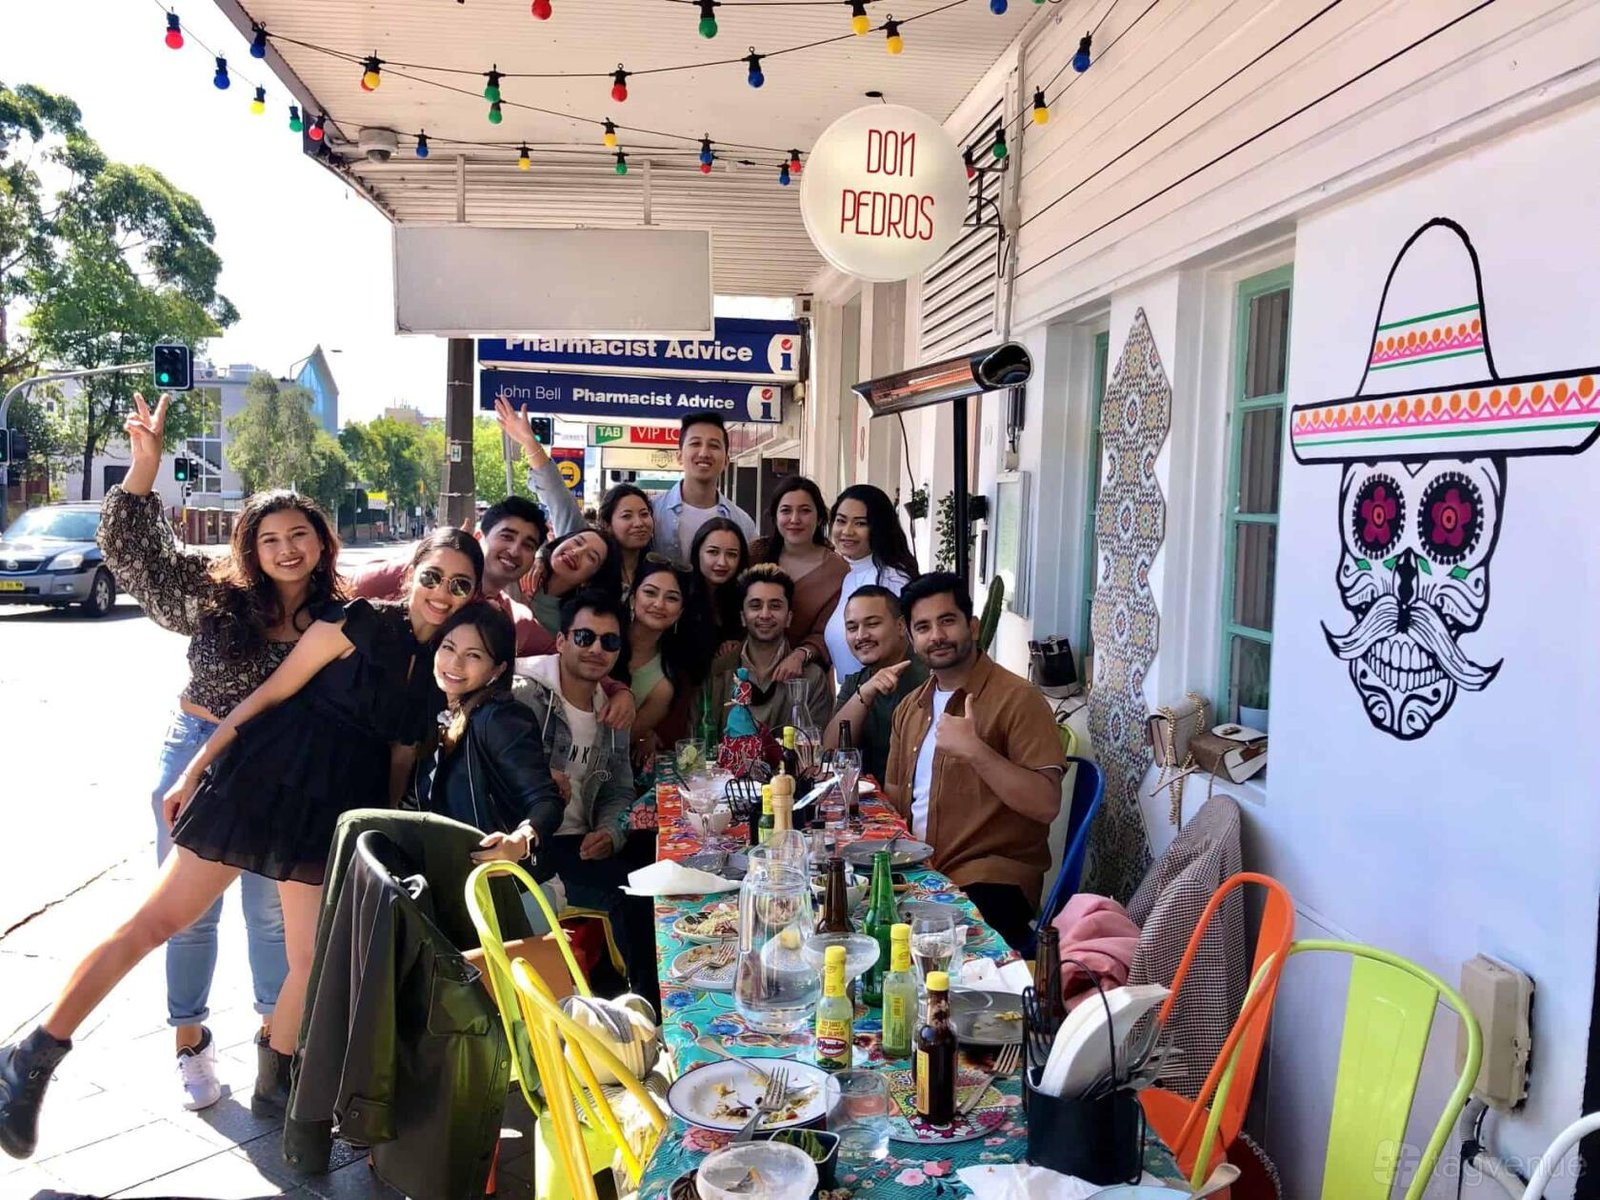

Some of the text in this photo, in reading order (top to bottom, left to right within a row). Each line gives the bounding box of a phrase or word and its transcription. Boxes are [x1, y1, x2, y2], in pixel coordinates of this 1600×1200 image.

[866, 129, 916, 177] DON
[841, 189, 935, 240] PEDROS
[505, 338, 753, 361] Pharmacist Advice
[495, 384, 735, 409] John Bell Pharmacist Advice
[598, 426, 621, 437] TAB
[636, 426, 660, 440] VIP
